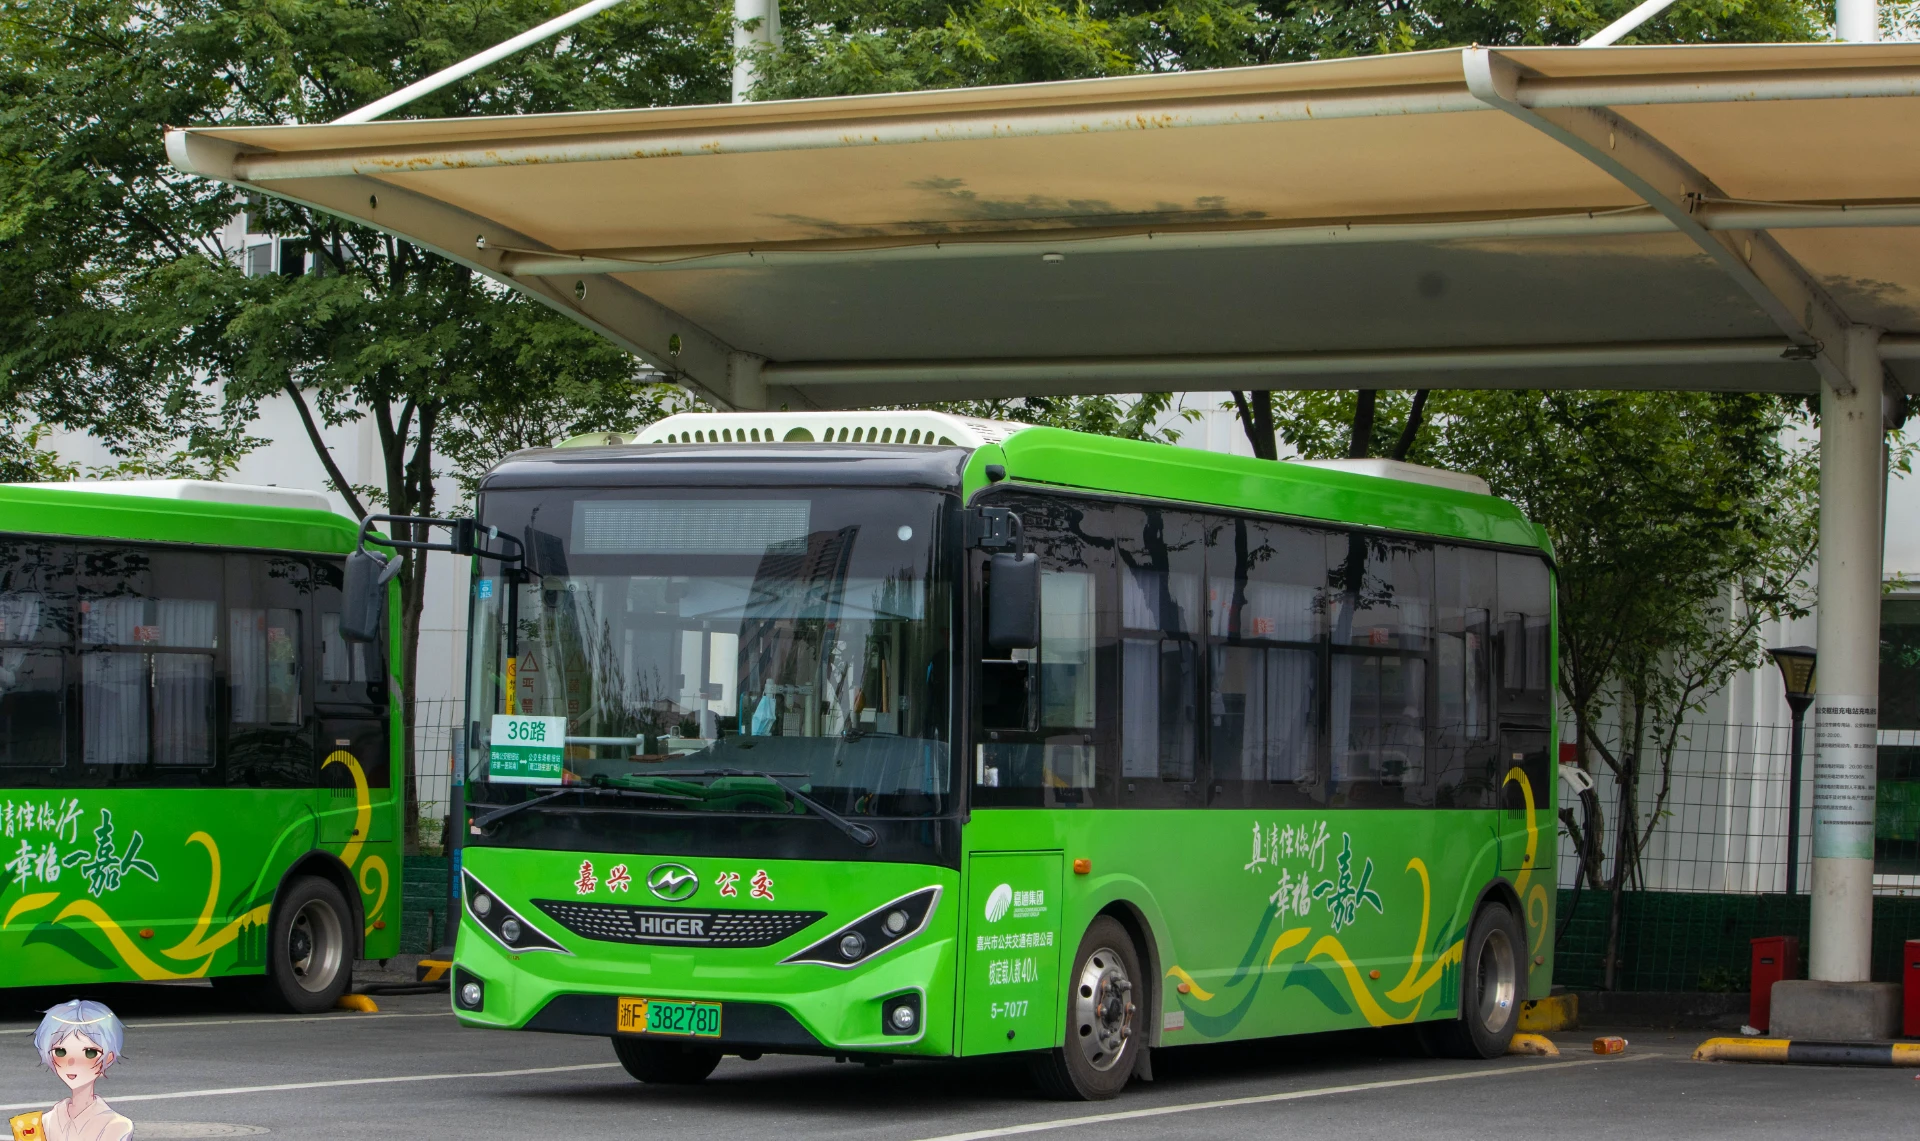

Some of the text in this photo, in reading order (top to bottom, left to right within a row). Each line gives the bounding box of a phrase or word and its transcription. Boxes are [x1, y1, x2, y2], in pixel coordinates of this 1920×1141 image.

[507, 721, 546, 742] 36路
[1244, 820, 1330, 873] 真情伴你行
[1013, 890, 1044, 907] 嘉通集团
[640, 917, 704, 935] HIGER
[976, 931, 1054, 951] 嘉兴市公共交通有限公司
[991, 1000, 1028, 1019] 5-7077
